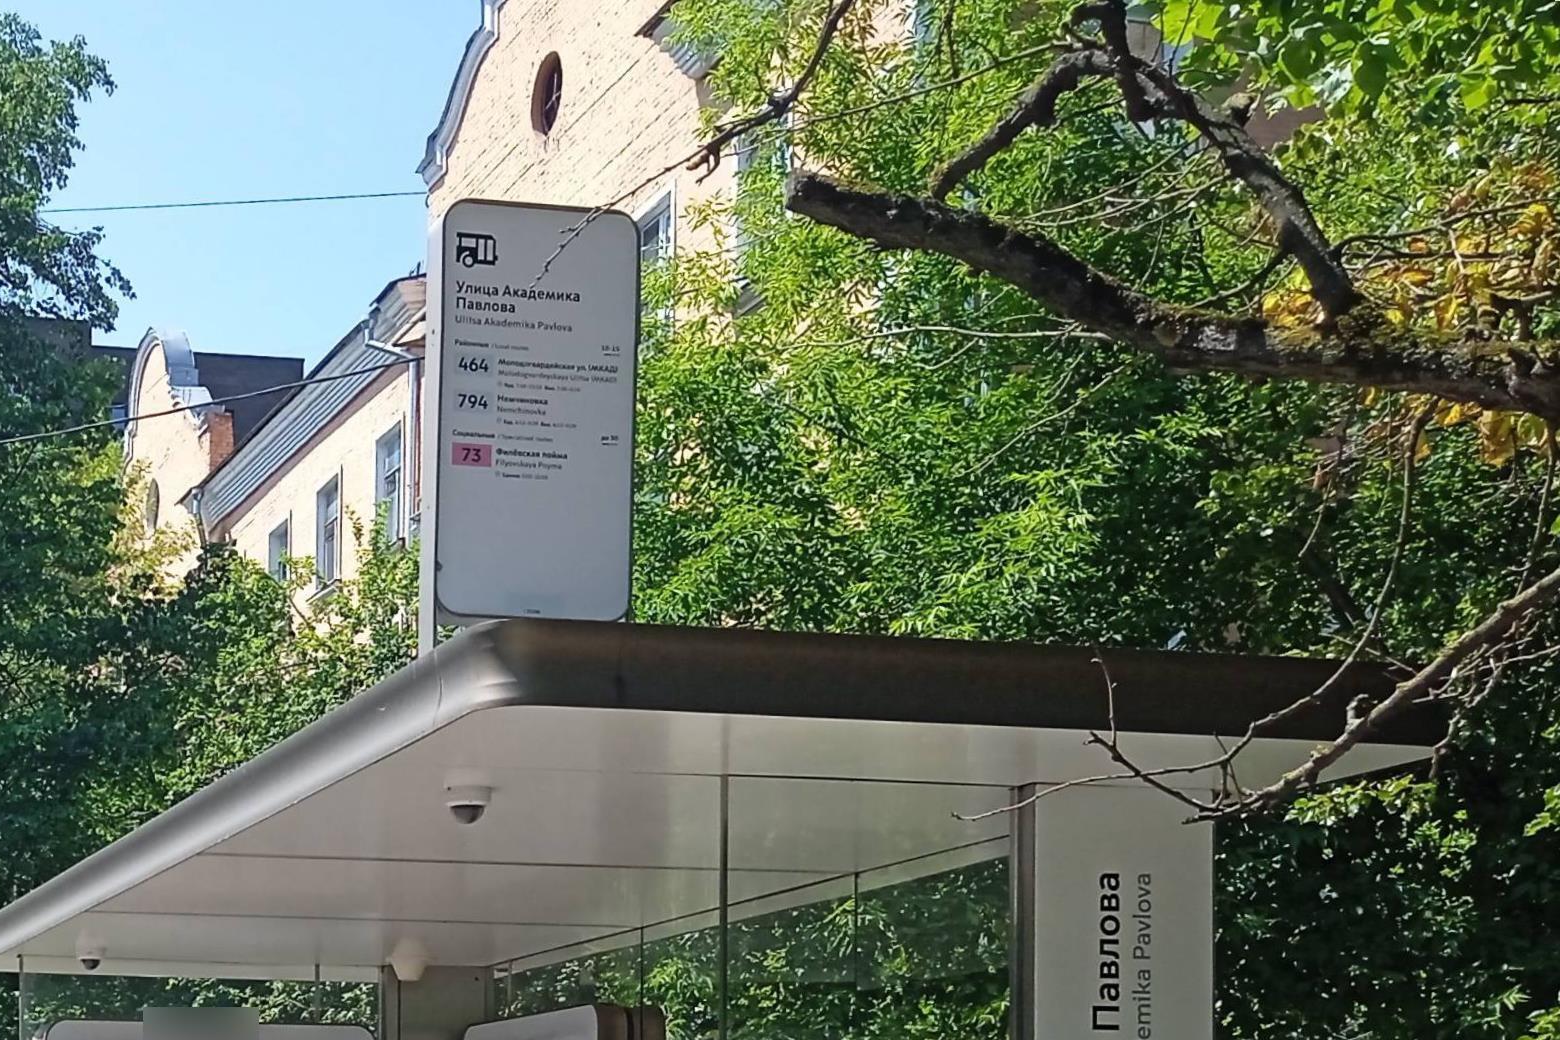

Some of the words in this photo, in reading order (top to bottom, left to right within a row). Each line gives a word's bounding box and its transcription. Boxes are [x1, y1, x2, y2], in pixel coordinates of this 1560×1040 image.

[456, 280, 499, 297] Улица
[502, 285, 581, 302] Академика
[456, 296, 516, 313] Павлова
[455, 315, 482, 325] Ulitsa
[484, 318, 536, 330] Akademika
[537, 321, 573, 332] Pavlova
[458, 357, 489, 373] 464
[457, 394, 489, 410] 794
[461, 448, 482, 463] 73
[1132, 873, 1151, 960] Pavlova
[1092, 873, 1121, 1031] Павлова
